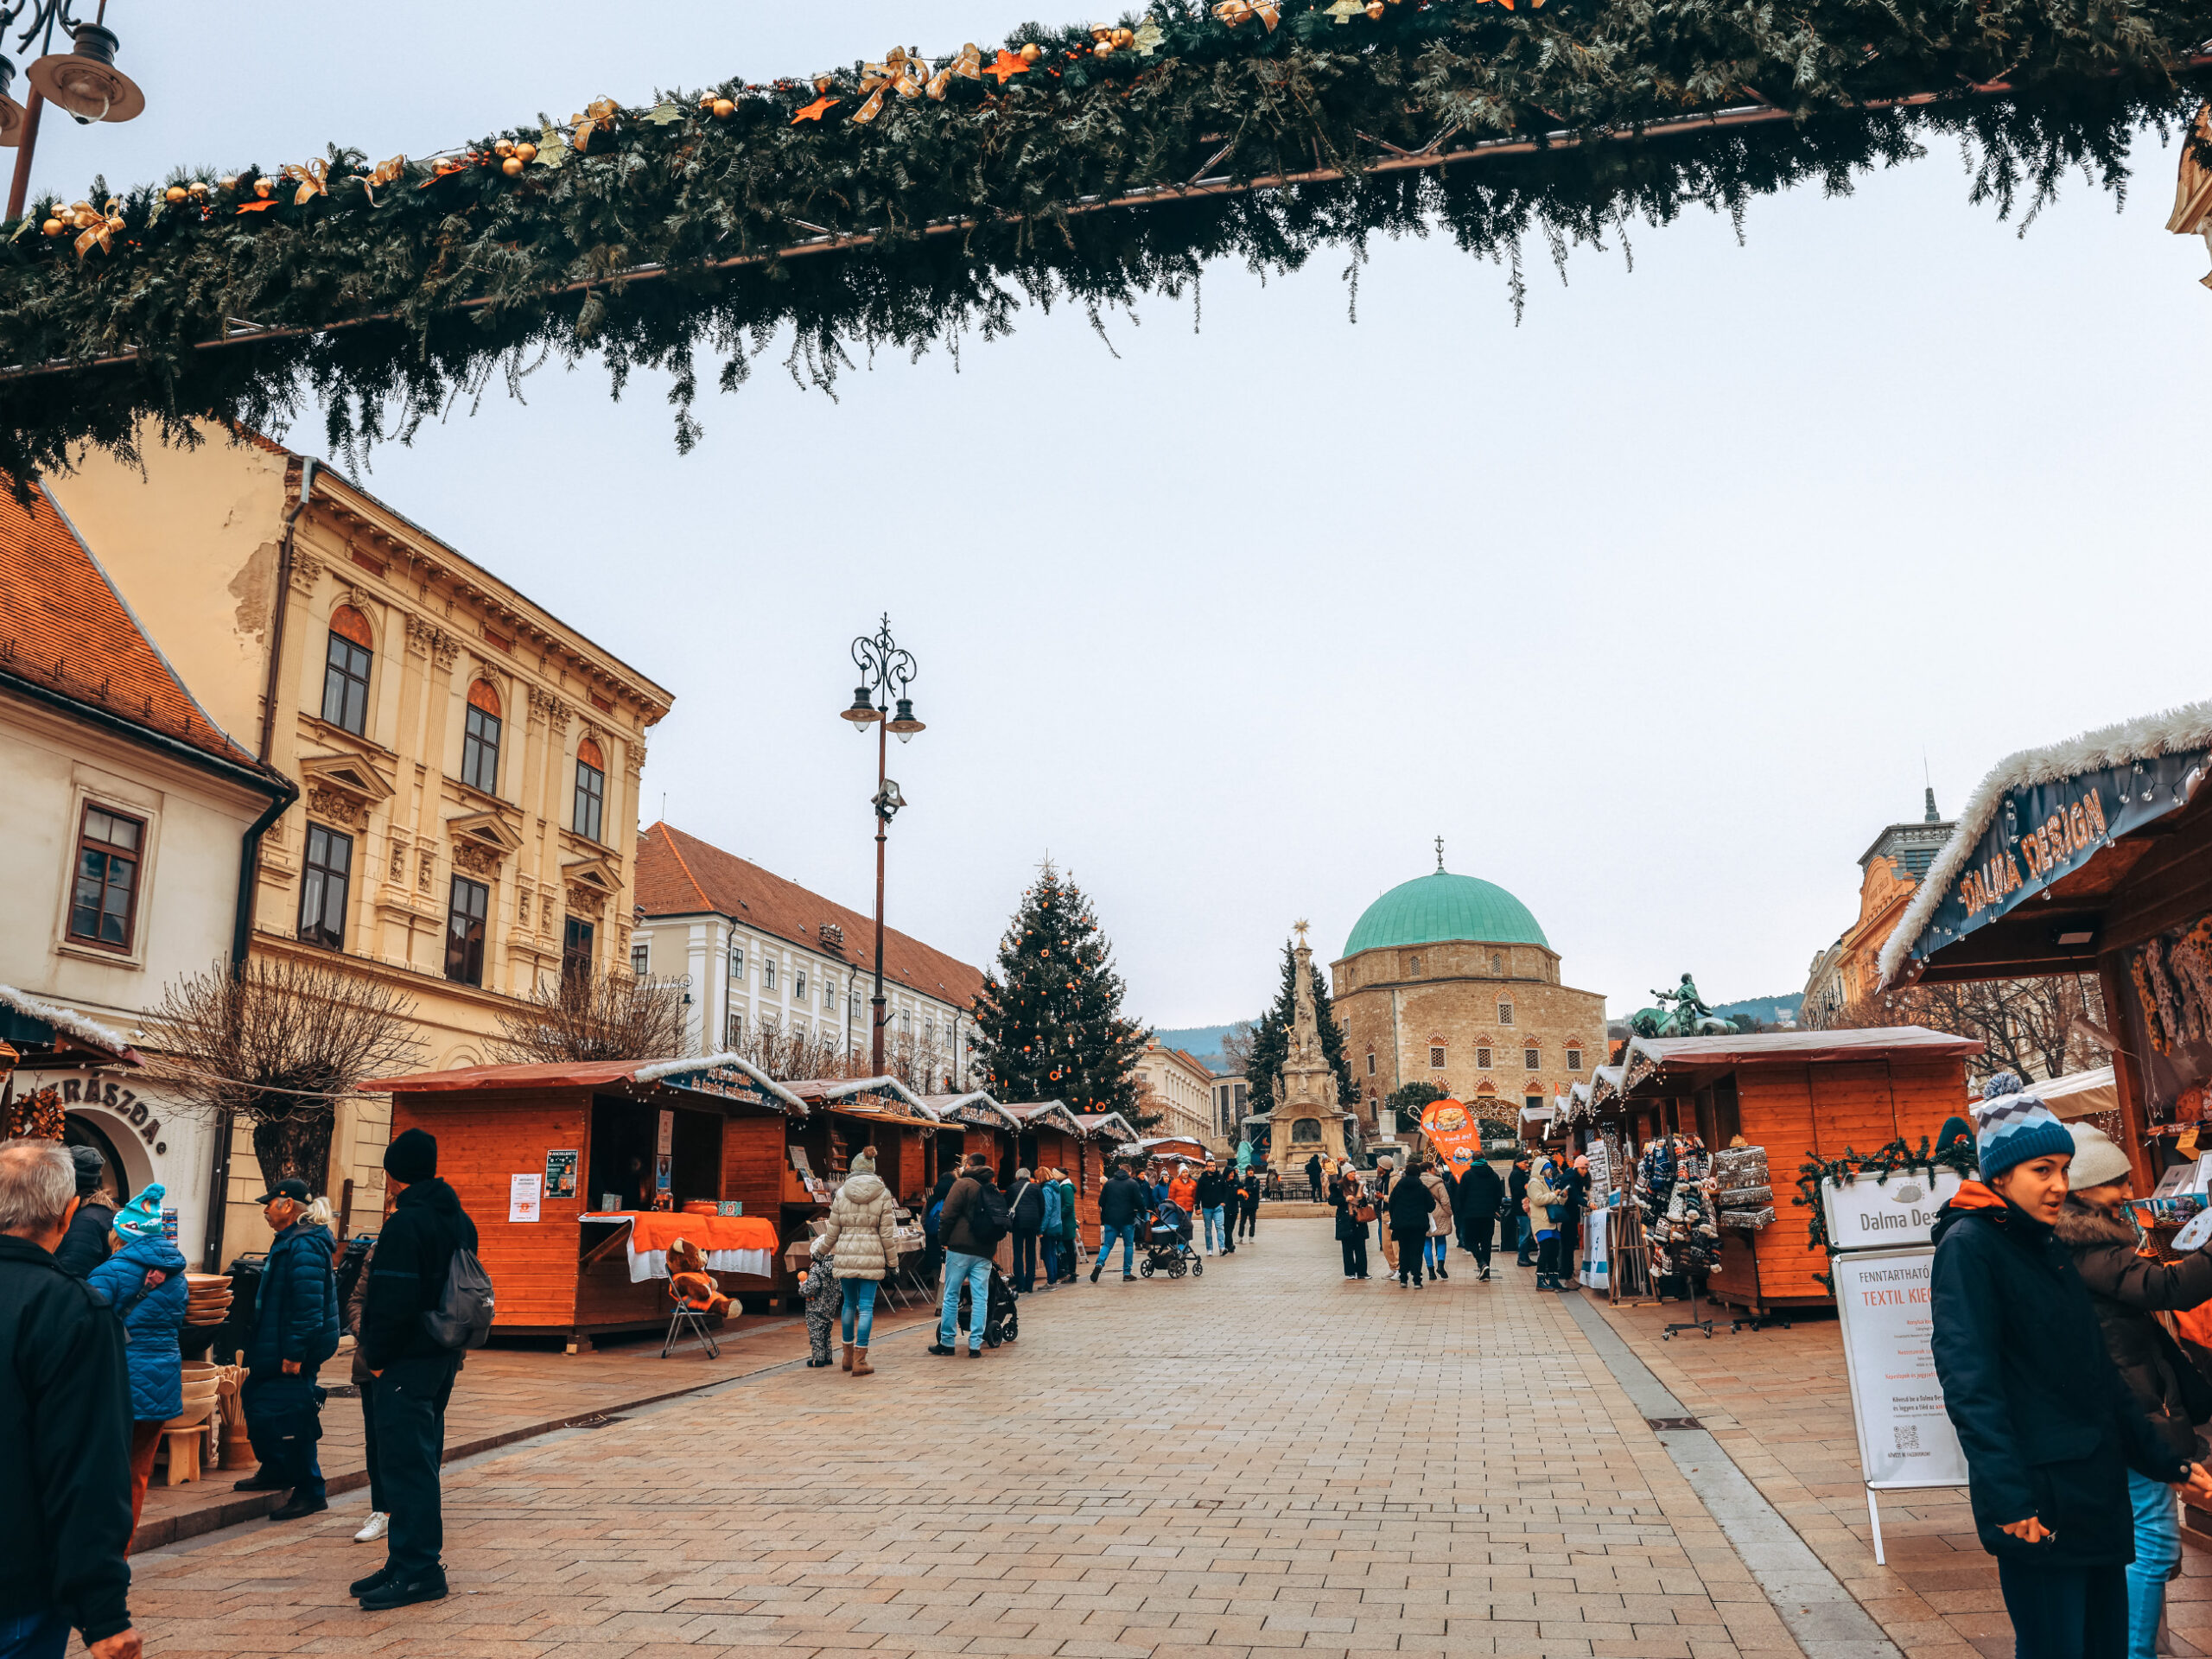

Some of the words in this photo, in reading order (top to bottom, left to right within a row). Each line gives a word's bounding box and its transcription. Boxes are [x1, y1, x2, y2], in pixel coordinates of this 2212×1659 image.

[1960, 849, 2024, 918] DALMA
[2020, 787, 2107, 880] DESIGN
[1860, 1211, 1907, 1230] Dalma
[1859, 1264, 1929, 1283] FENNTARTHATÓ
[1861, 1289, 1905, 1306] TEXTIL
